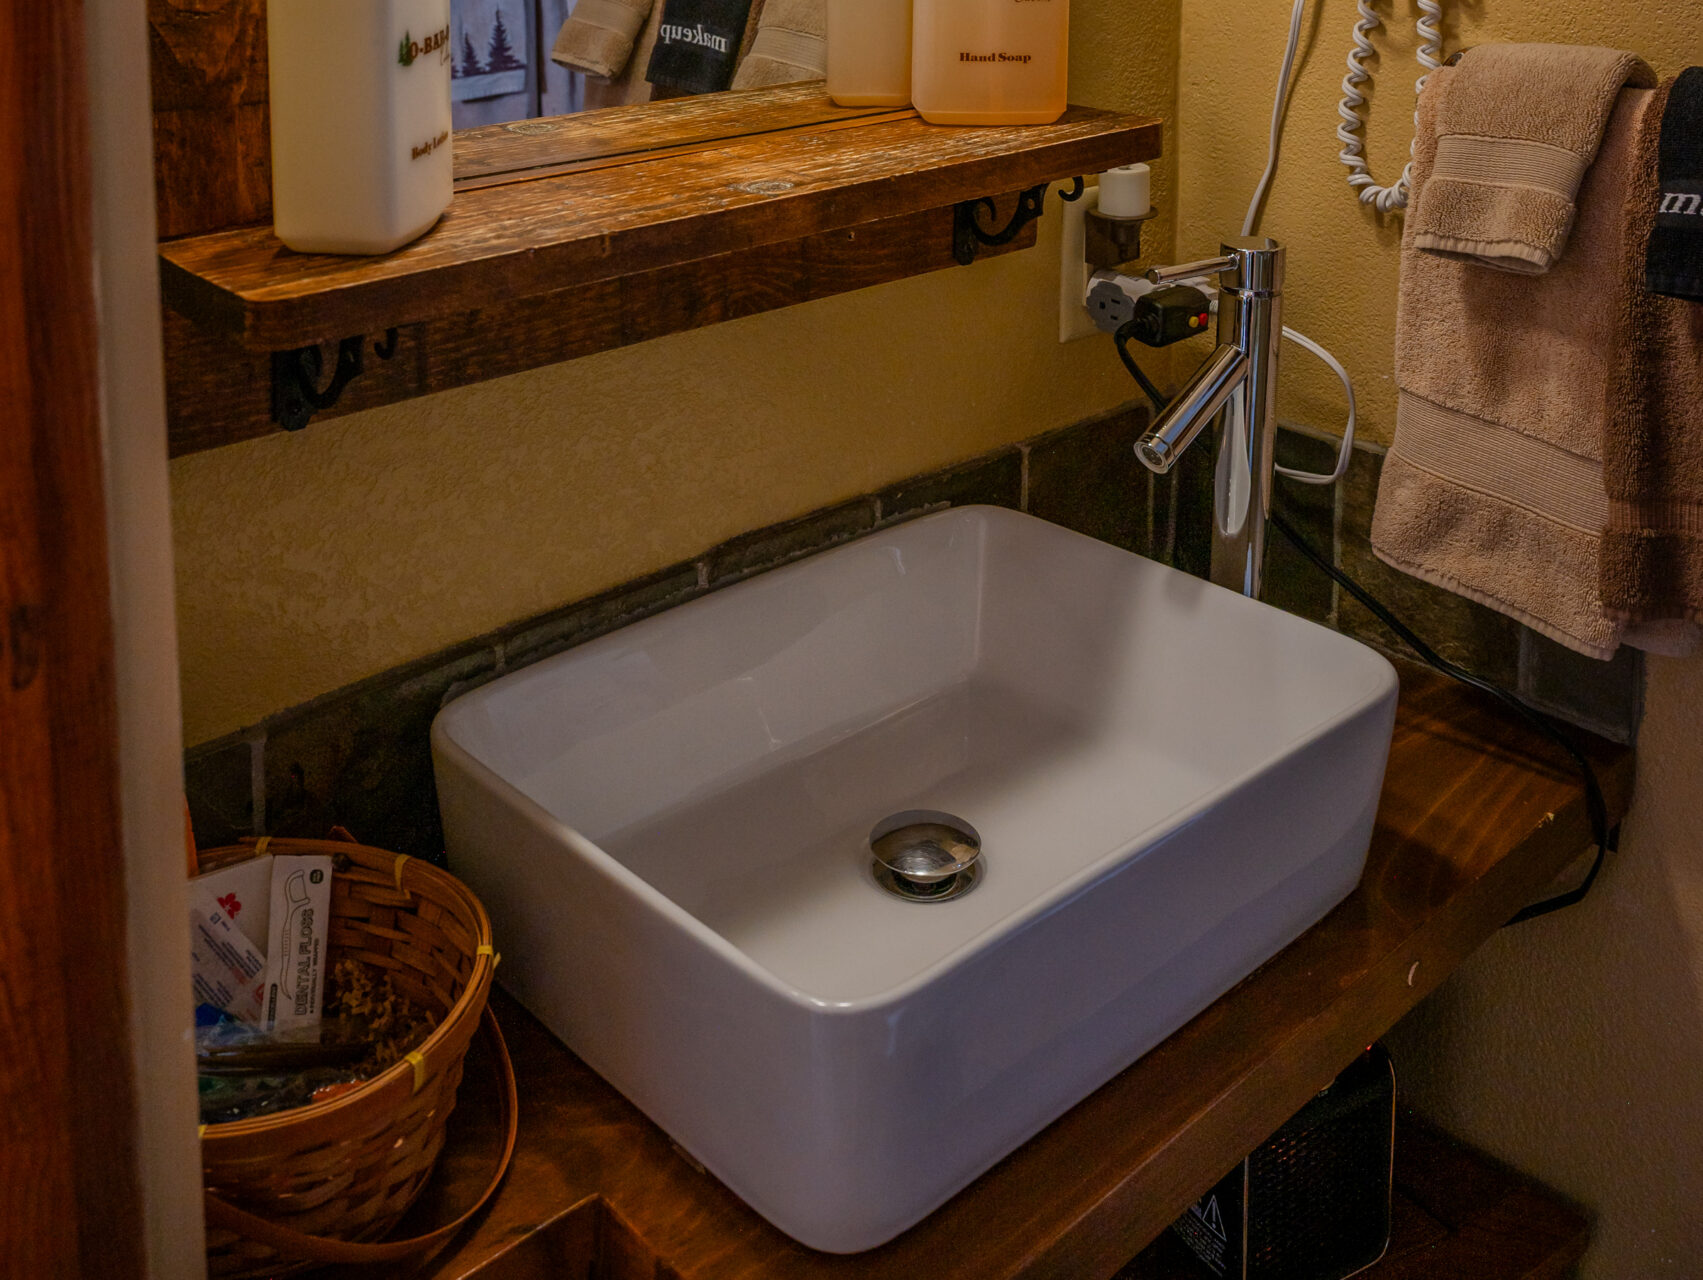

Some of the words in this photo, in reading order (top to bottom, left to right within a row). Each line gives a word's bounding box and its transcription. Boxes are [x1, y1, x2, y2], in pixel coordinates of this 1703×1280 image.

[959, 52, 996, 62] Hand
[998, 52, 1032, 64] Soap
[1659, 192, 1703, 216] m
[299, 908, 315, 956] FLOSS
[294, 961, 311, 1016] DENTAL
